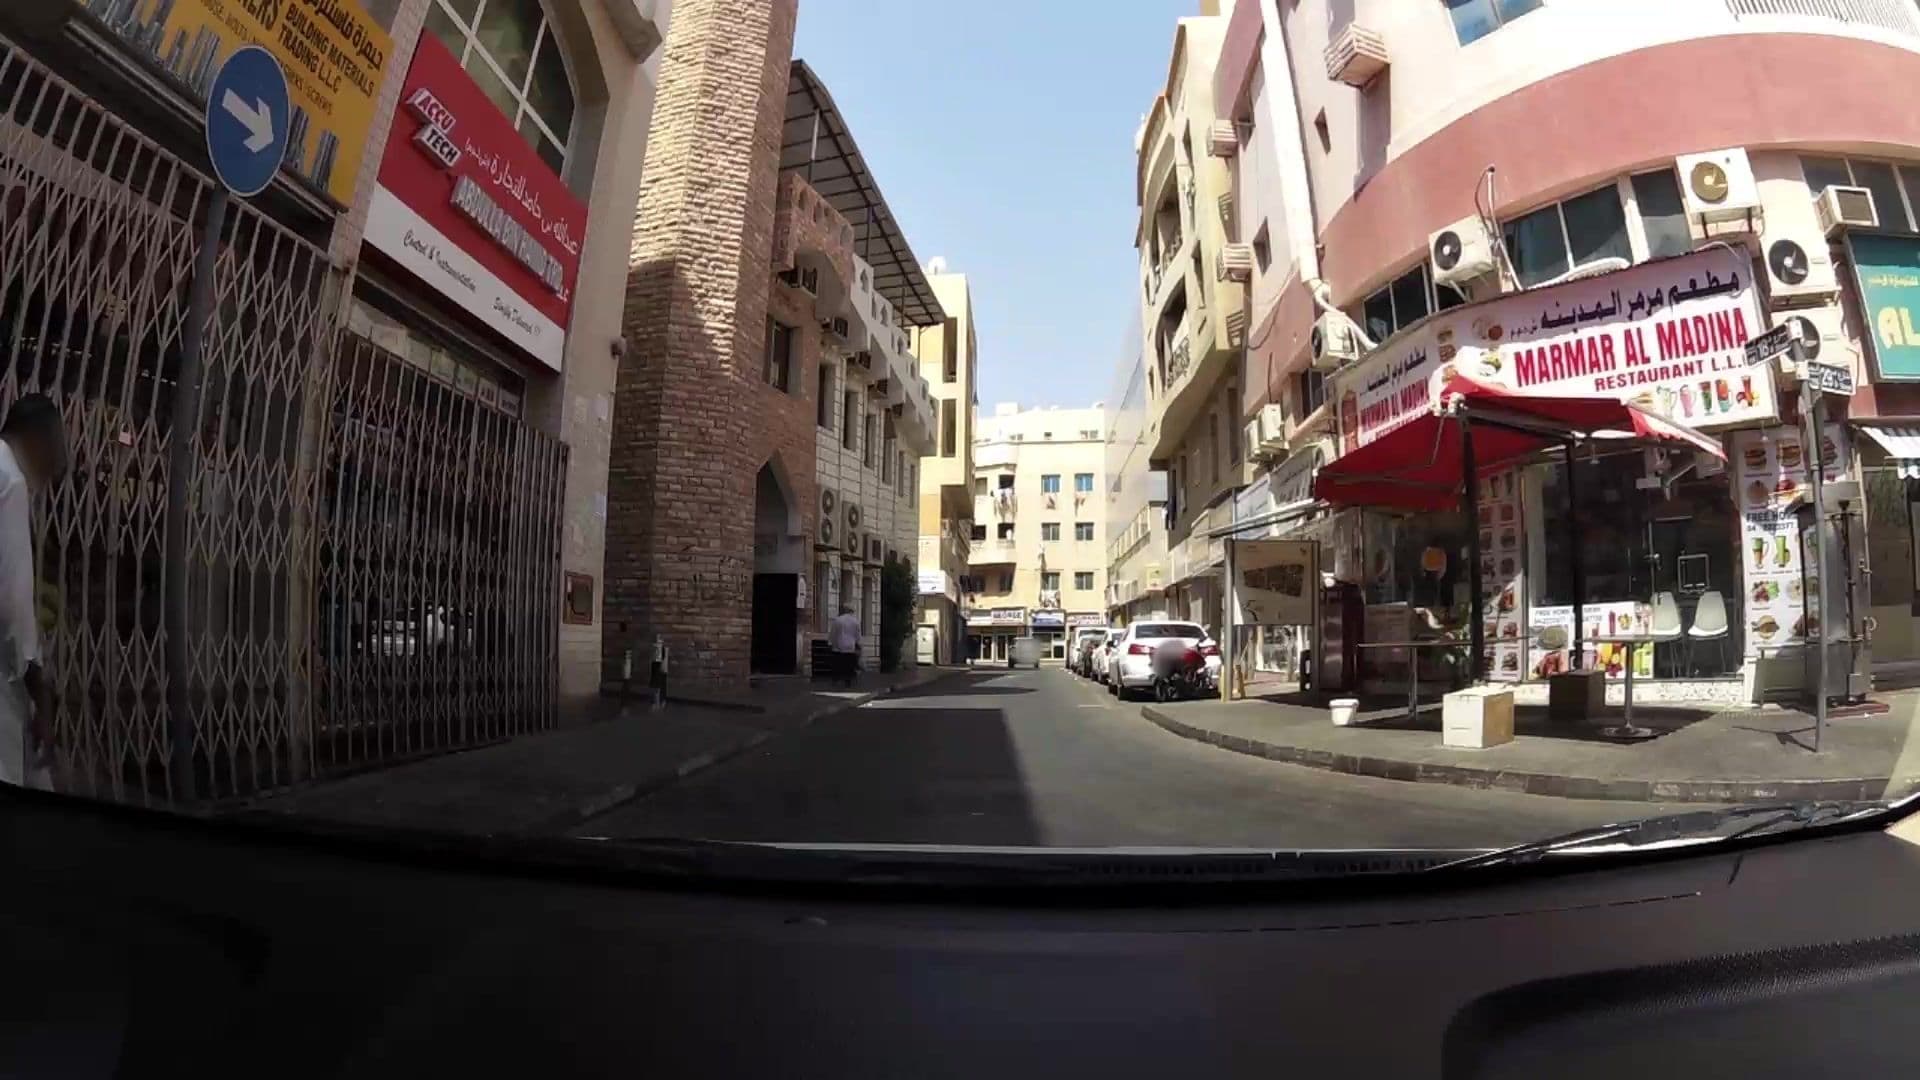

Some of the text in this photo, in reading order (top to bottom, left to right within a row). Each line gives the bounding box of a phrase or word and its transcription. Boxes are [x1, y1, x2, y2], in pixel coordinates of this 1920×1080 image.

[278, 23, 319, 74] TRADING
[285, 4, 328, 53] BUILDING
[328, 43, 375, 98] MATERIALS
[418, 95, 455, 131] ACCU
[426, 128, 459, 163] TECH
[1513, 336, 1617, 388] MARMAR
[1623, 326, 1651, 368] AL
[1655, 307, 1749, 361] MADINA
[1594, 359, 1704, 392] RESTAURANT
